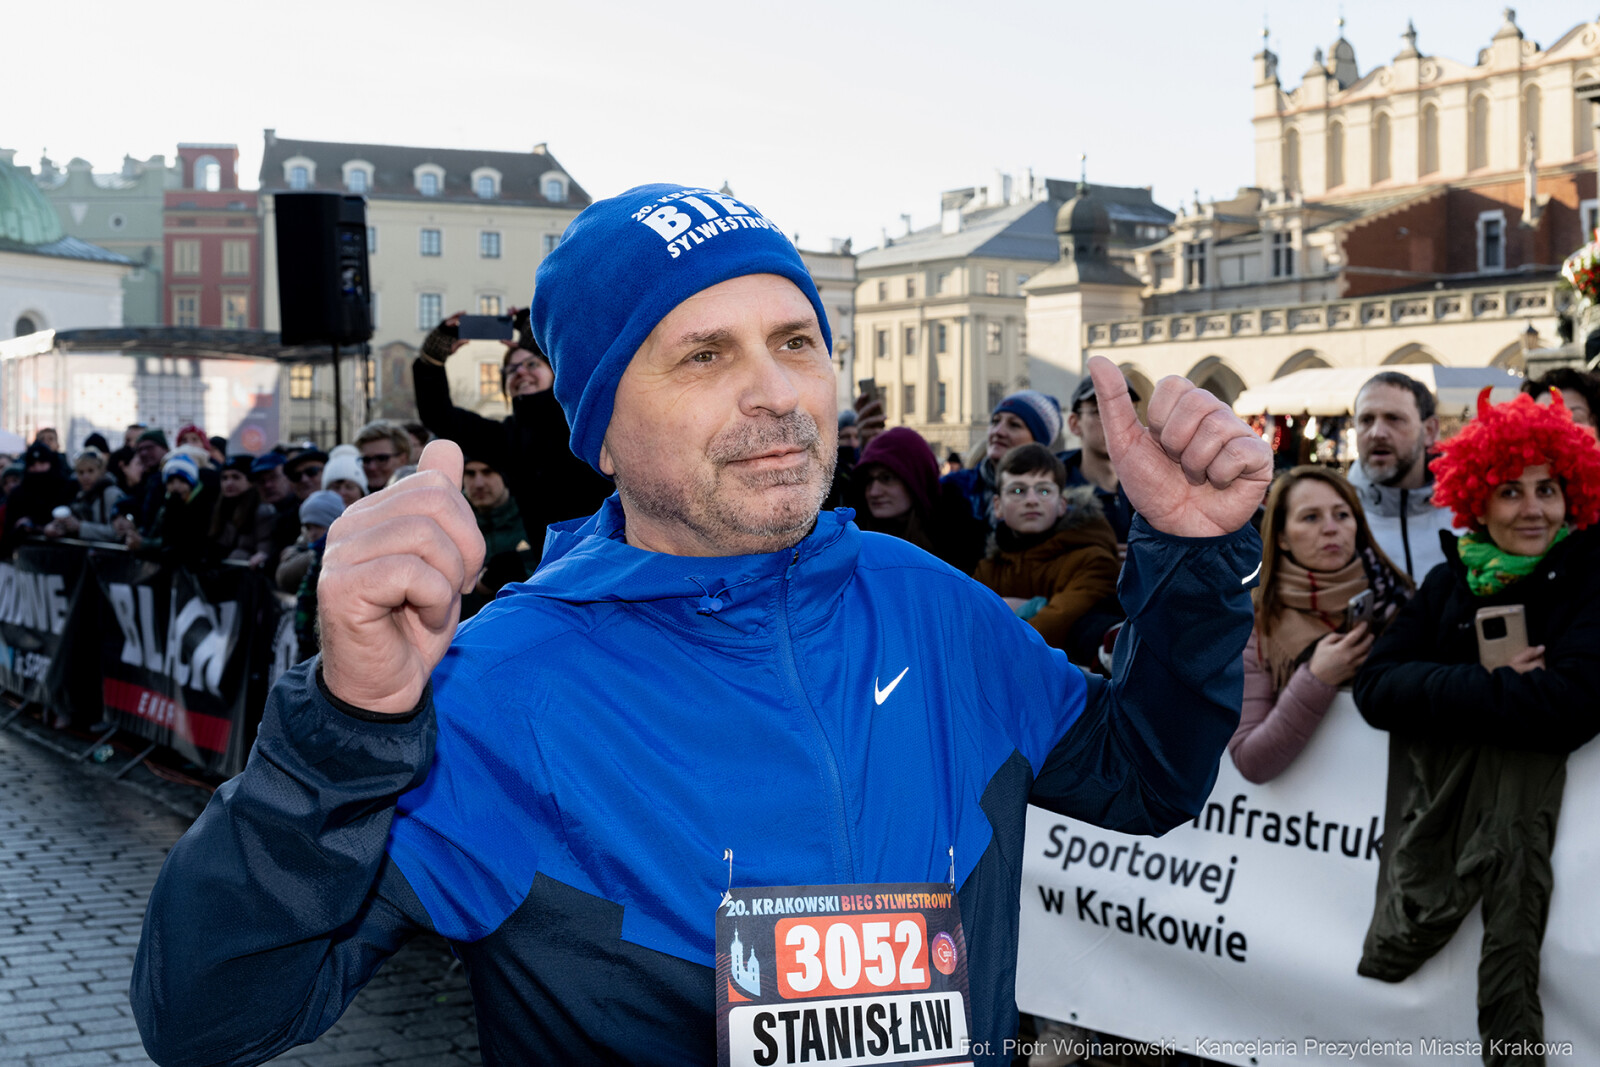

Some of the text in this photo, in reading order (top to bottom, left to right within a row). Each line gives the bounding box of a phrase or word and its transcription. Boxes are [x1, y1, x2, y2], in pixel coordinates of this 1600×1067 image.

[667, 215, 782, 259] SYLWESTRO
[1043, 823, 1238, 905] Sportowej
[726, 892, 952, 917] 20. KRAKOWSKI BIEG SYLWESTROWY
[1038, 884, 1248, 963] w Krakowie
[785, 920, 926, 993] 3052
[753, 998, 954, 1067] STANISŁAW
